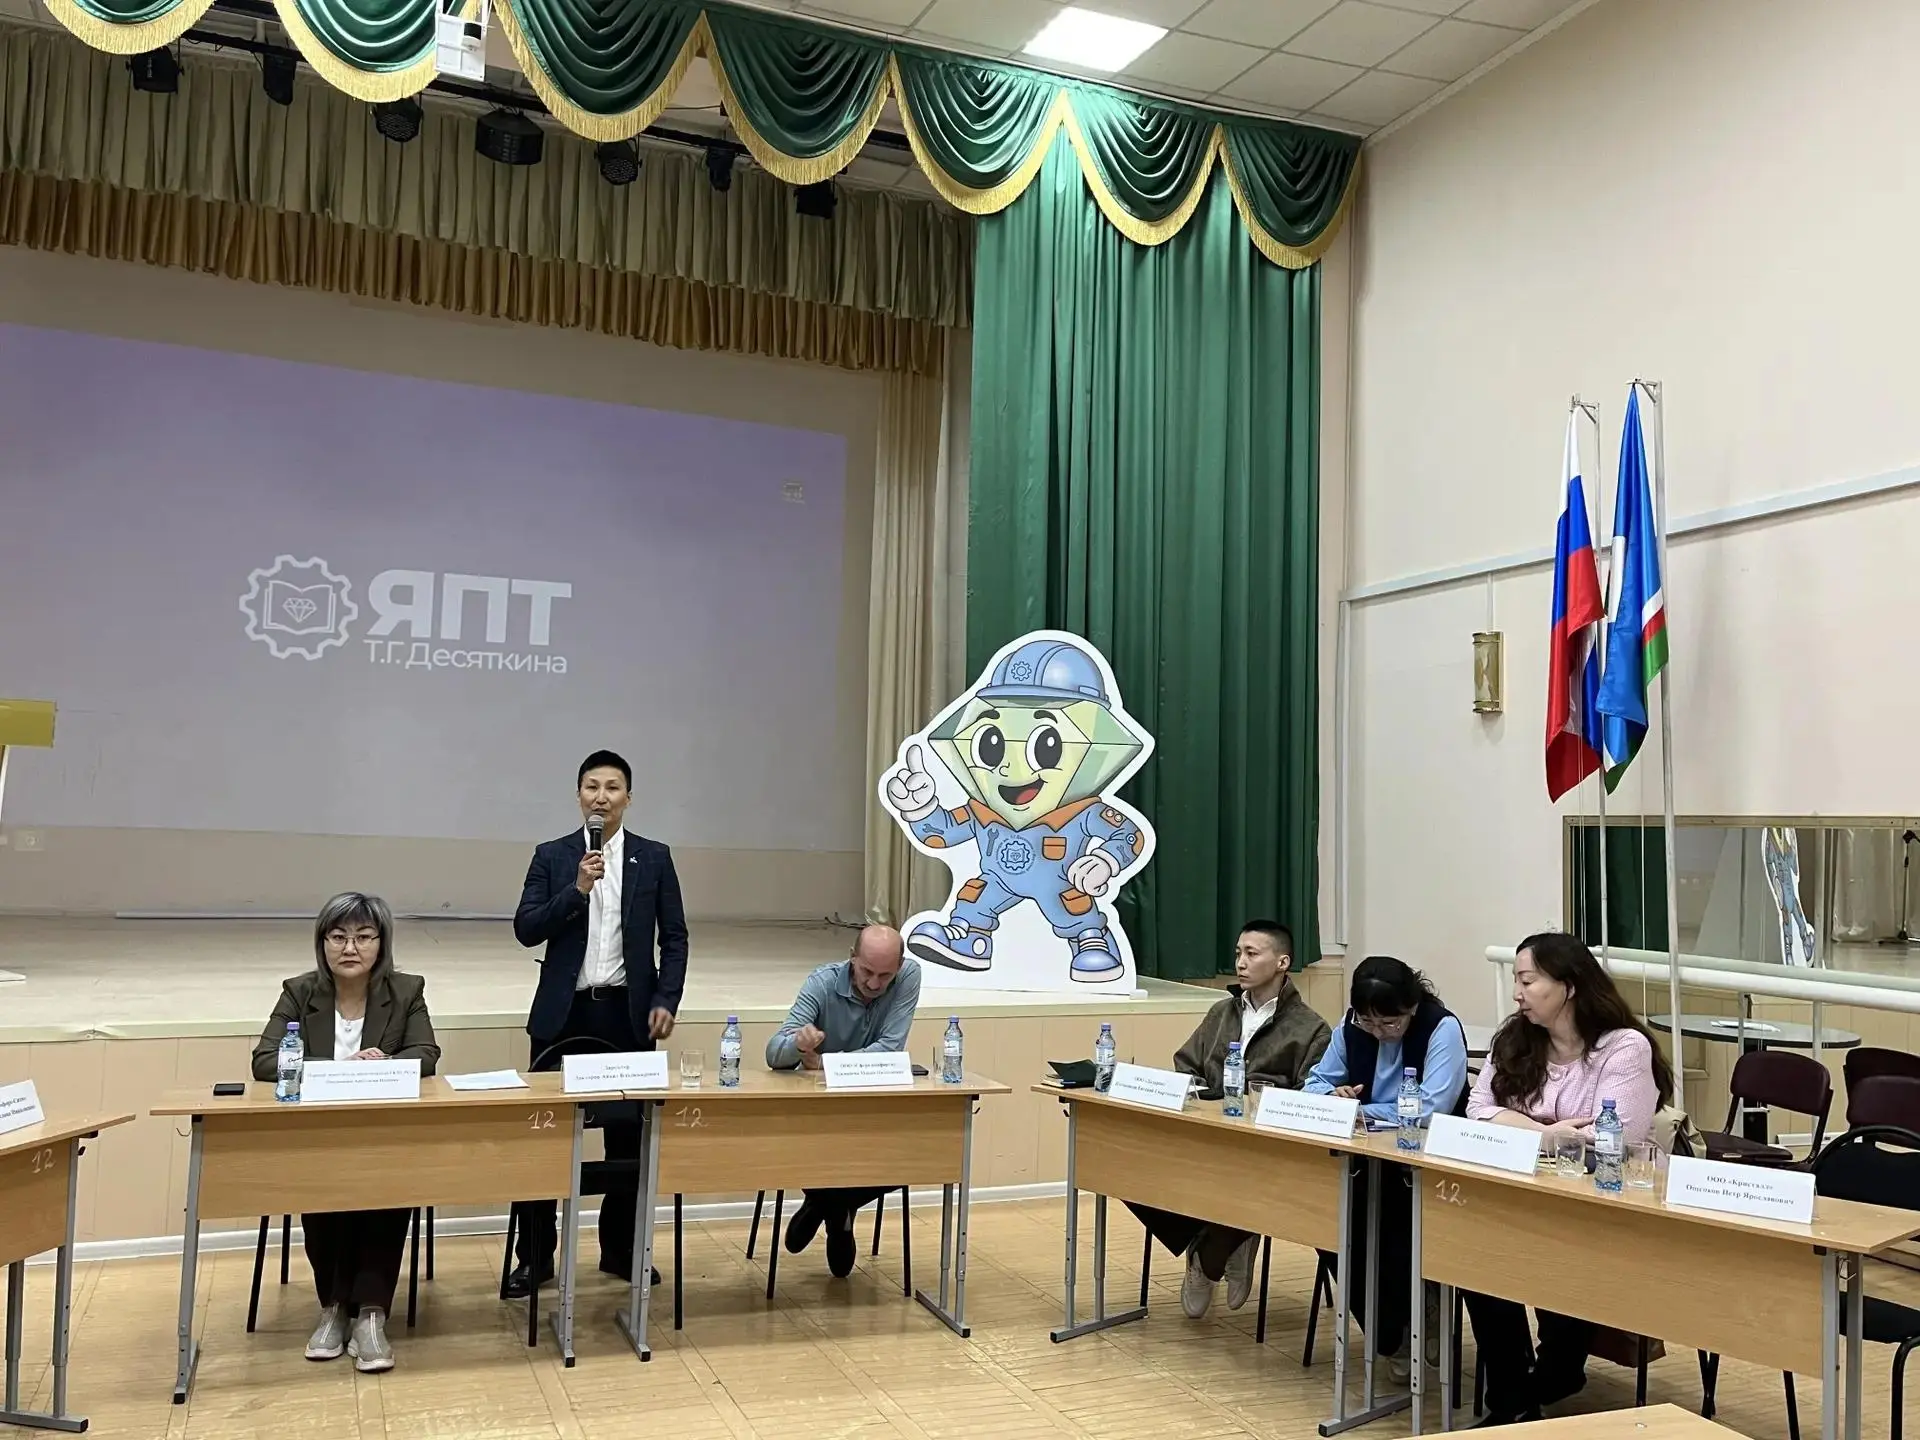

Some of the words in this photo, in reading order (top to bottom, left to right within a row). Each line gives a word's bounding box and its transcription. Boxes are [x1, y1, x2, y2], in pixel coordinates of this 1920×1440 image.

[366, 569, 573, 646] ЯПТ
[527, 1110, 557, 1130] 12
[674, 1106, 708, 1128] 12
[31, 1148, 57, 1174] 12
[1435, 1179, 1468, 1207] 12
